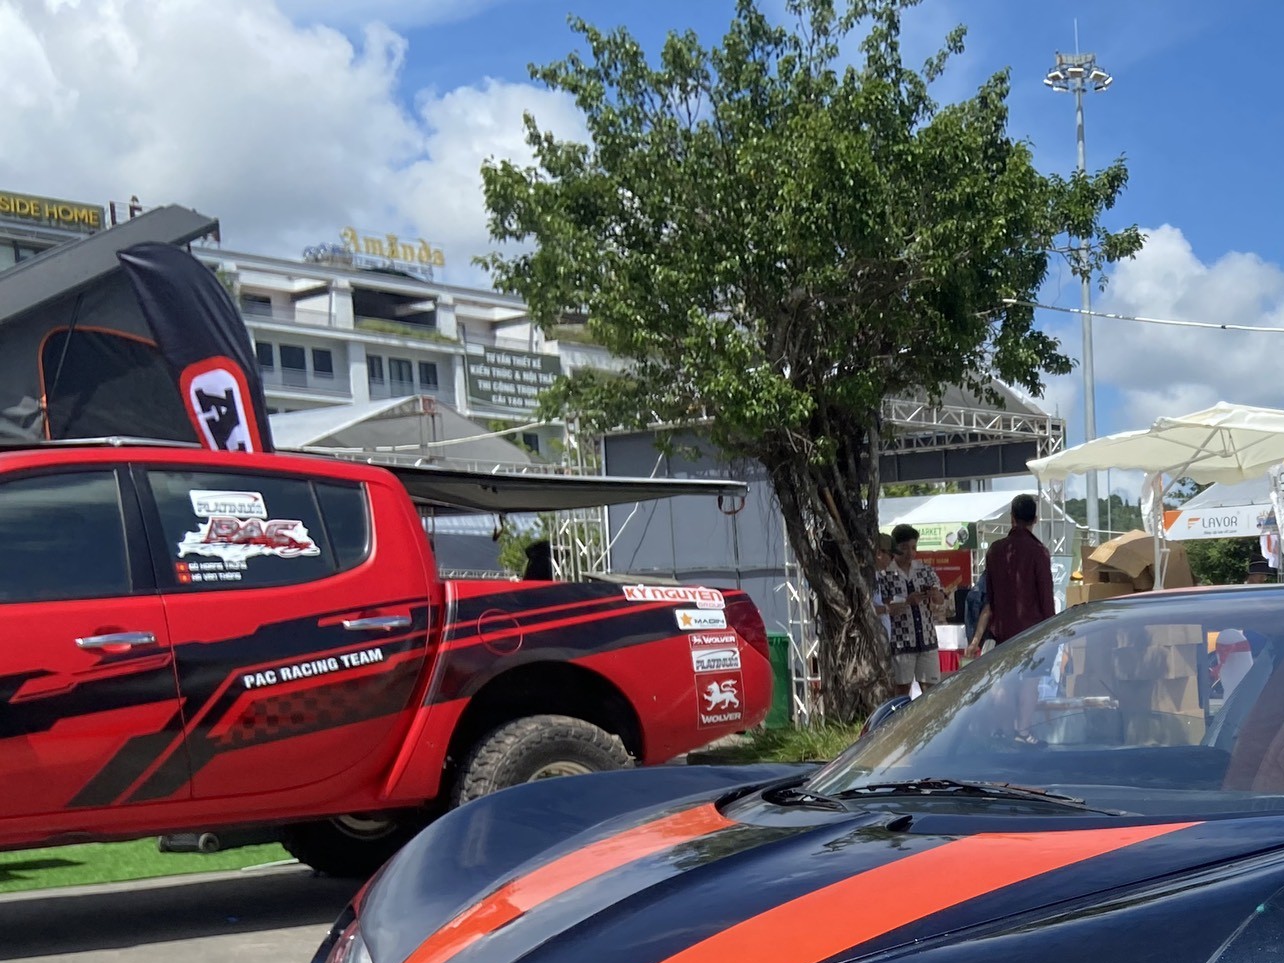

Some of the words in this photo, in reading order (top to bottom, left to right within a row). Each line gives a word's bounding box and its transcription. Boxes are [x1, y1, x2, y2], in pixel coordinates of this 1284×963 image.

[45, 204, 98, 225] HOME
[703, 635, 735, 644] WOLVER
[243, 671, 277, 688] PAC
[280, 658, 339, 681] RACING
[340, 648, 383, 668] TEAM
[696, 657, 738, 670] PLATINUM
[701, 712, 741, 724] WOLVER
